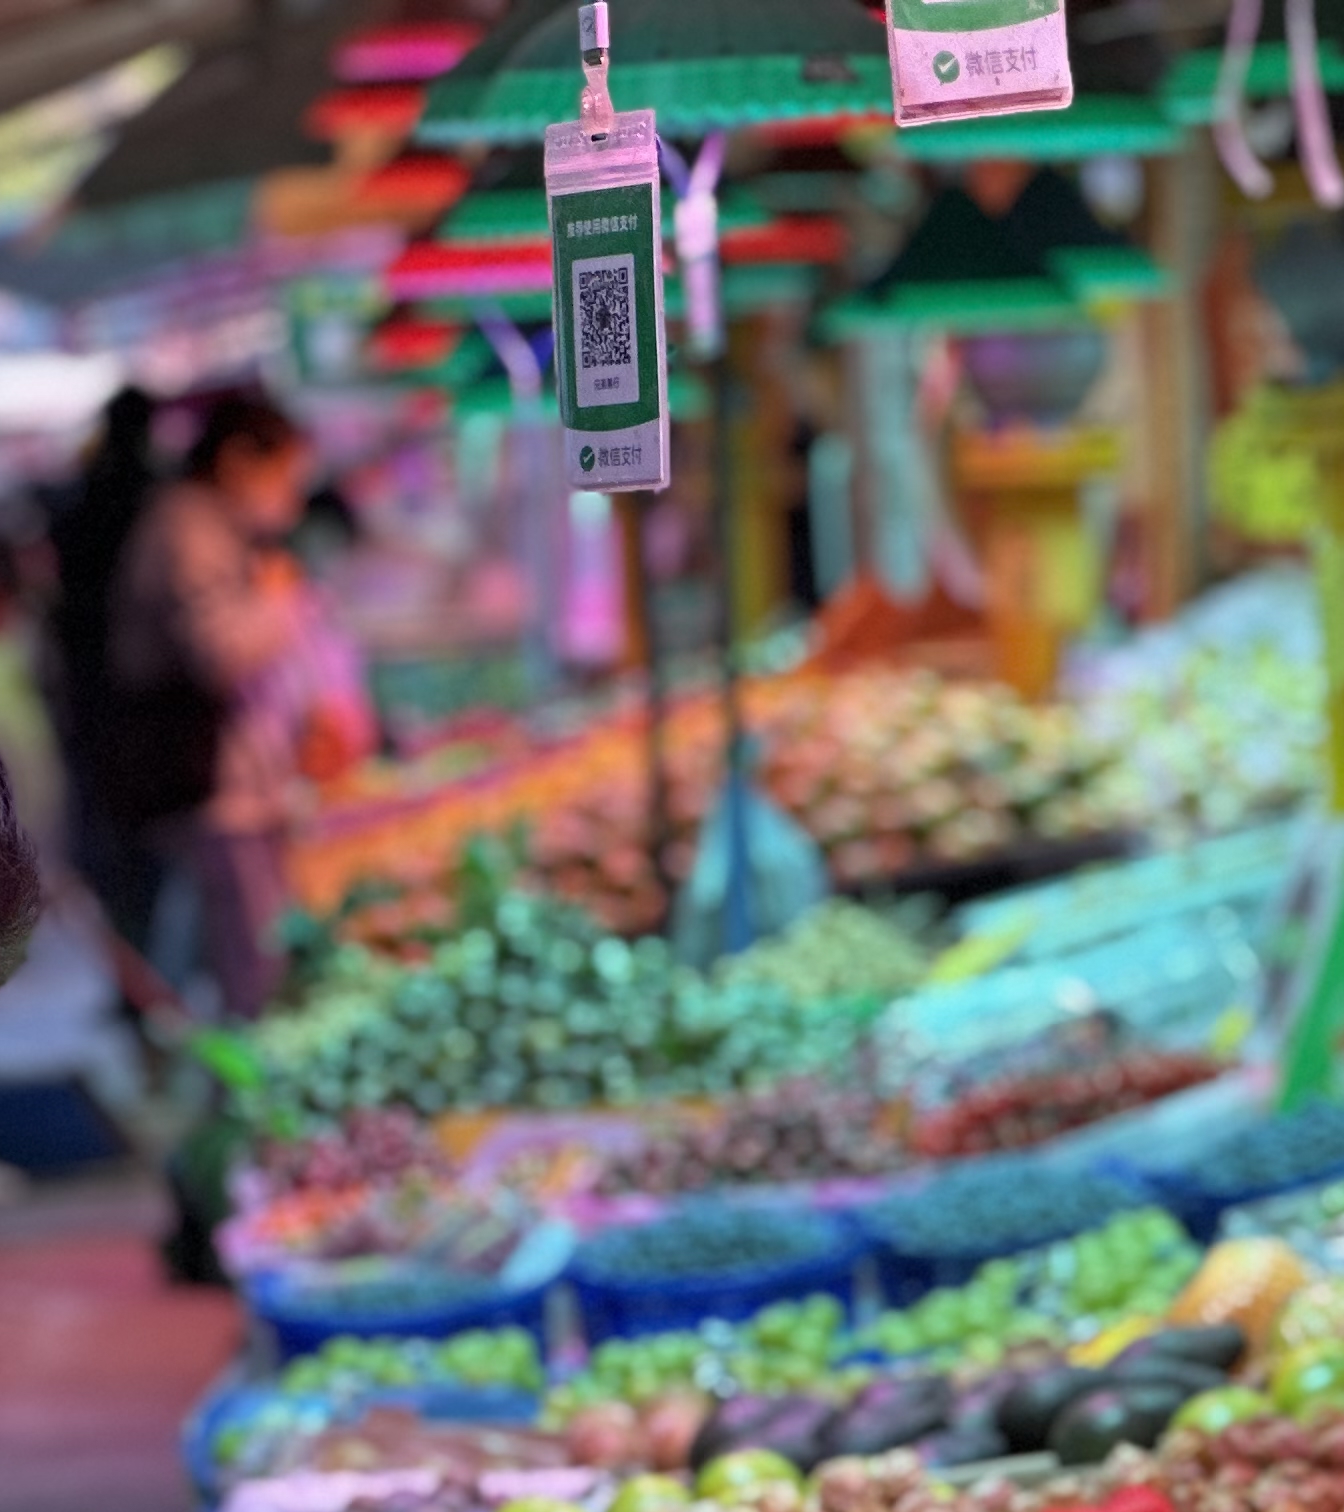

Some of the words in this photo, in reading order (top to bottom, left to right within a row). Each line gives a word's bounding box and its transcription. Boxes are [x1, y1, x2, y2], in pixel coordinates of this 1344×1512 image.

[964, 46, 1037, 77] 微信支付
[597, 445, 642, 467] 微信支付
